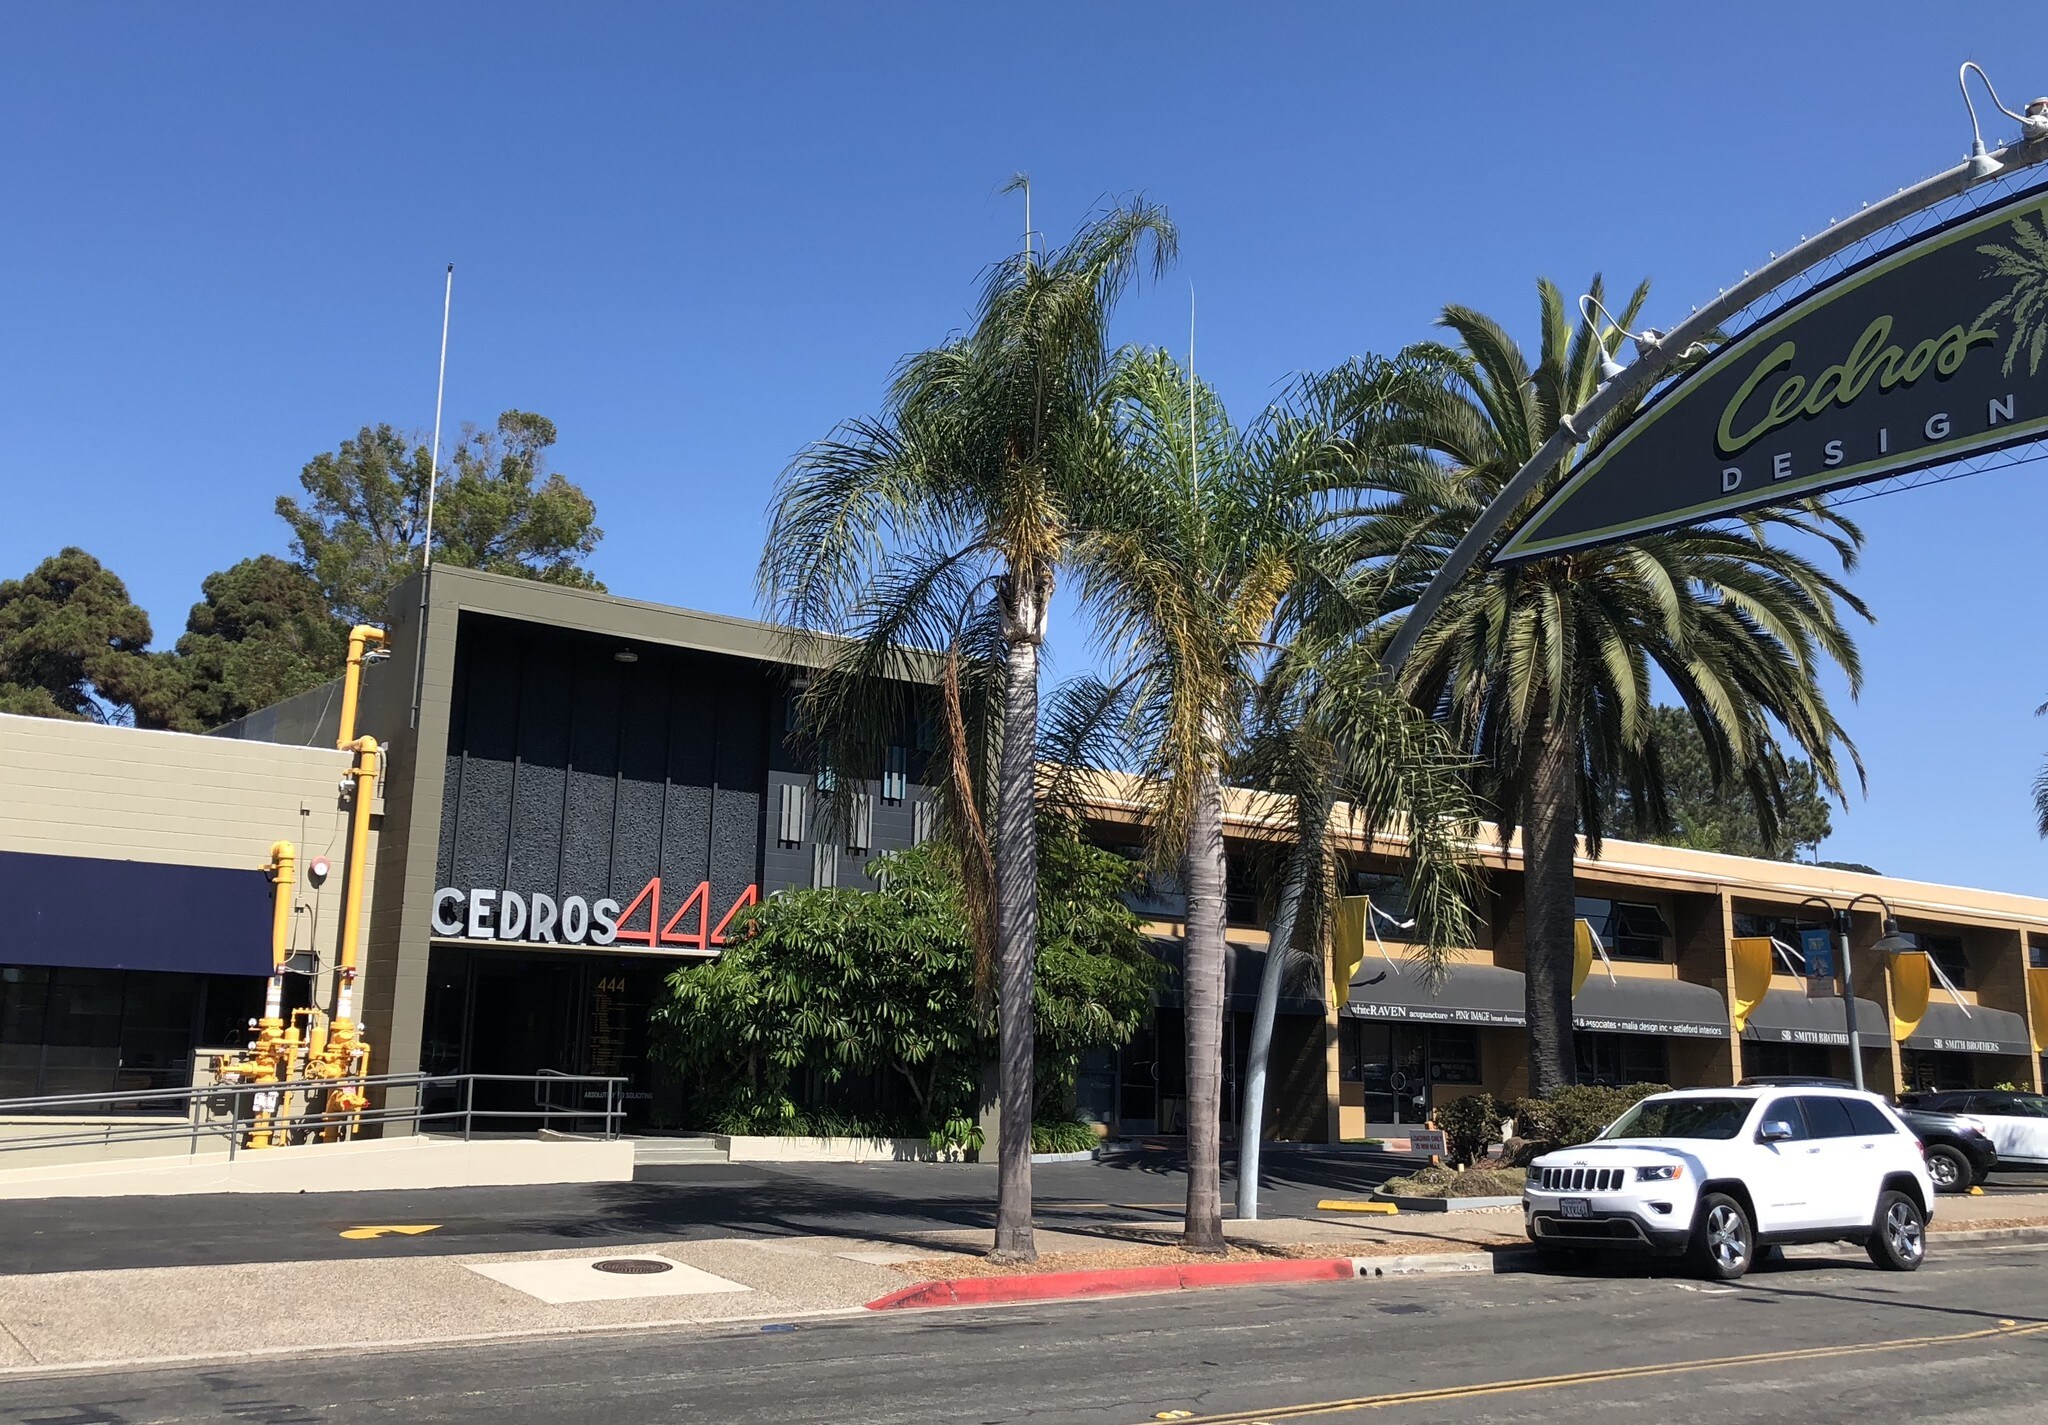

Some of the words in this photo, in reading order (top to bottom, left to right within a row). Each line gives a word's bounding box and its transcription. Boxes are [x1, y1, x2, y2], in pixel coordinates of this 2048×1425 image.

[1717, 315, 1998, 453] Cedros
[1722, 394, 2014, 492] DESIGN
[431, 887, 620, 945] CEDROS
[598, 977, 625, 993] 444
[1351, 1003, 1406, 1017] whiteRAVEN
[1409, 1011, 1448, 1020] acupuncture
[1471, 1011, 1490, 1022] IMAGE
[1580, 1018, 1585, 1027] &
[1585, 1019, 1617, 1029] associates
[1622, 1021, 1638, 1031] malia
[1639, 1022, 1658, 1033] design
[1658, 1022, 1668, 1032] inc
[1673, 1023, 1697, 1034] astleford
[1699, 1025, 1722, 1036] interiors
[1794, 1031, 1818, 1043] SMITH
[1818, 1032, 1849, 1045] BROTHE
[1945, 1039, 1966, 1051] SMITH
[1966, 1041, 2000, 1052] BROTHERS
